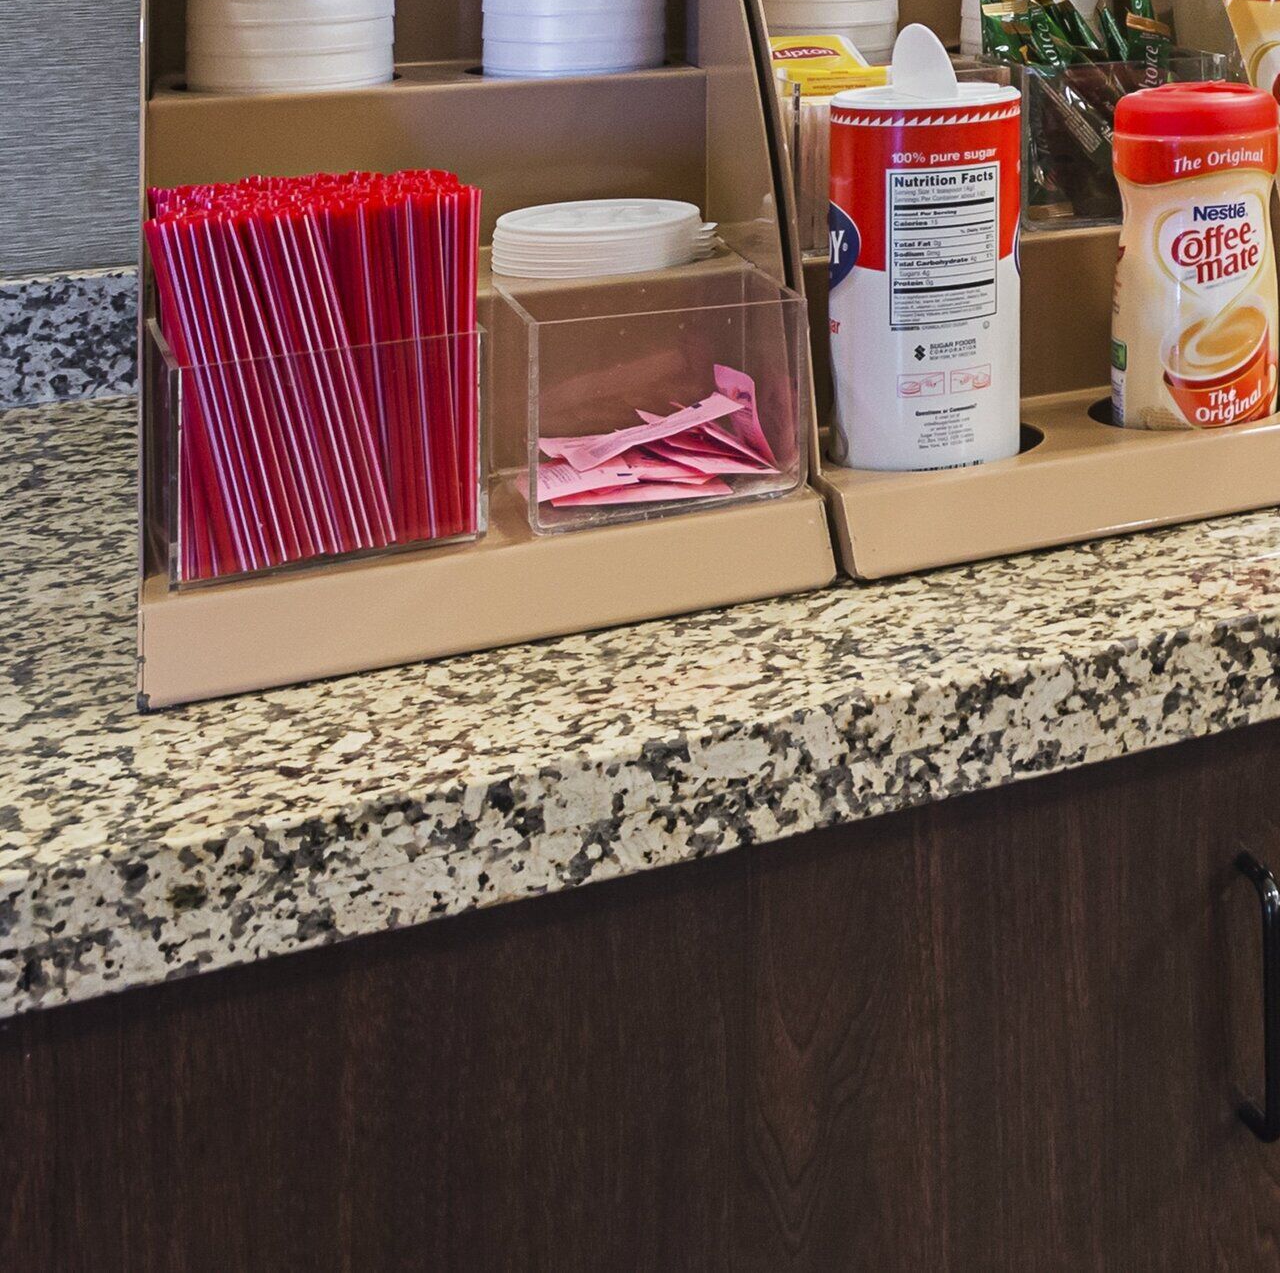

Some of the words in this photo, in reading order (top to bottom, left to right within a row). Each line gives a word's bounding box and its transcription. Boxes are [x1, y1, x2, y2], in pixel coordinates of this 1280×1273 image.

[774, 47, 834, 59] Lipton
[891, 152, 926, 164] 100%
[930, 152, 960, 164] pure
[963, 148, 997, 160] sugar
[1173, 156, 1202, 173] The
[1207, 147, 1264, 166] Original
[894, 175, 956, 187] Nutrition
[961, 171, 993, 184] Facts
[1193, 202, 1246, 222] Nestlé
[916, 257, 968, 267] Carbohydrate
[1196, 244, 1259, 284] mate
[1195, 379, 1262, 424] Original
[1209, 387, 1237, 406] The
